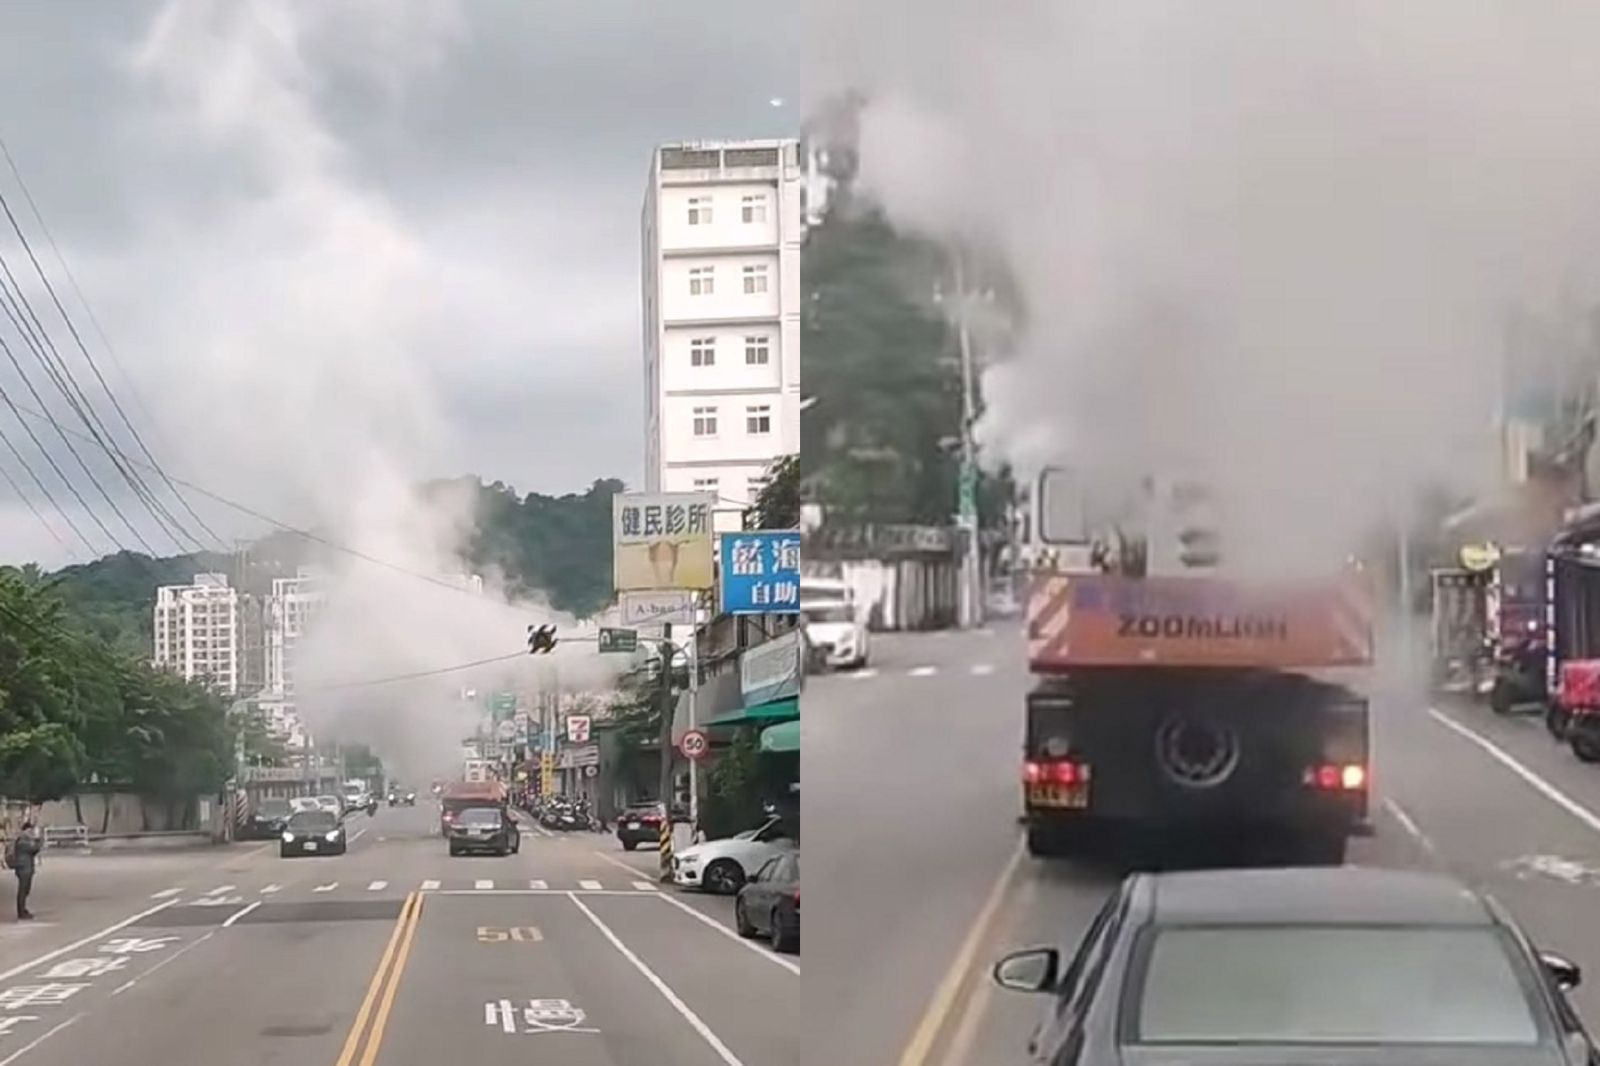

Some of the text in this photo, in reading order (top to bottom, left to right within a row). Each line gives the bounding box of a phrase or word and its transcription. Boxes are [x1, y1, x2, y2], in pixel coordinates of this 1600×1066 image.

[621, 503, 708, 536] 健民診所
[752, 581, 797, 605] 自助
[686, 736, 703, 750] 50
[477, 926, 544, 942] 50
[485, 999, 601, 1033] 慢
